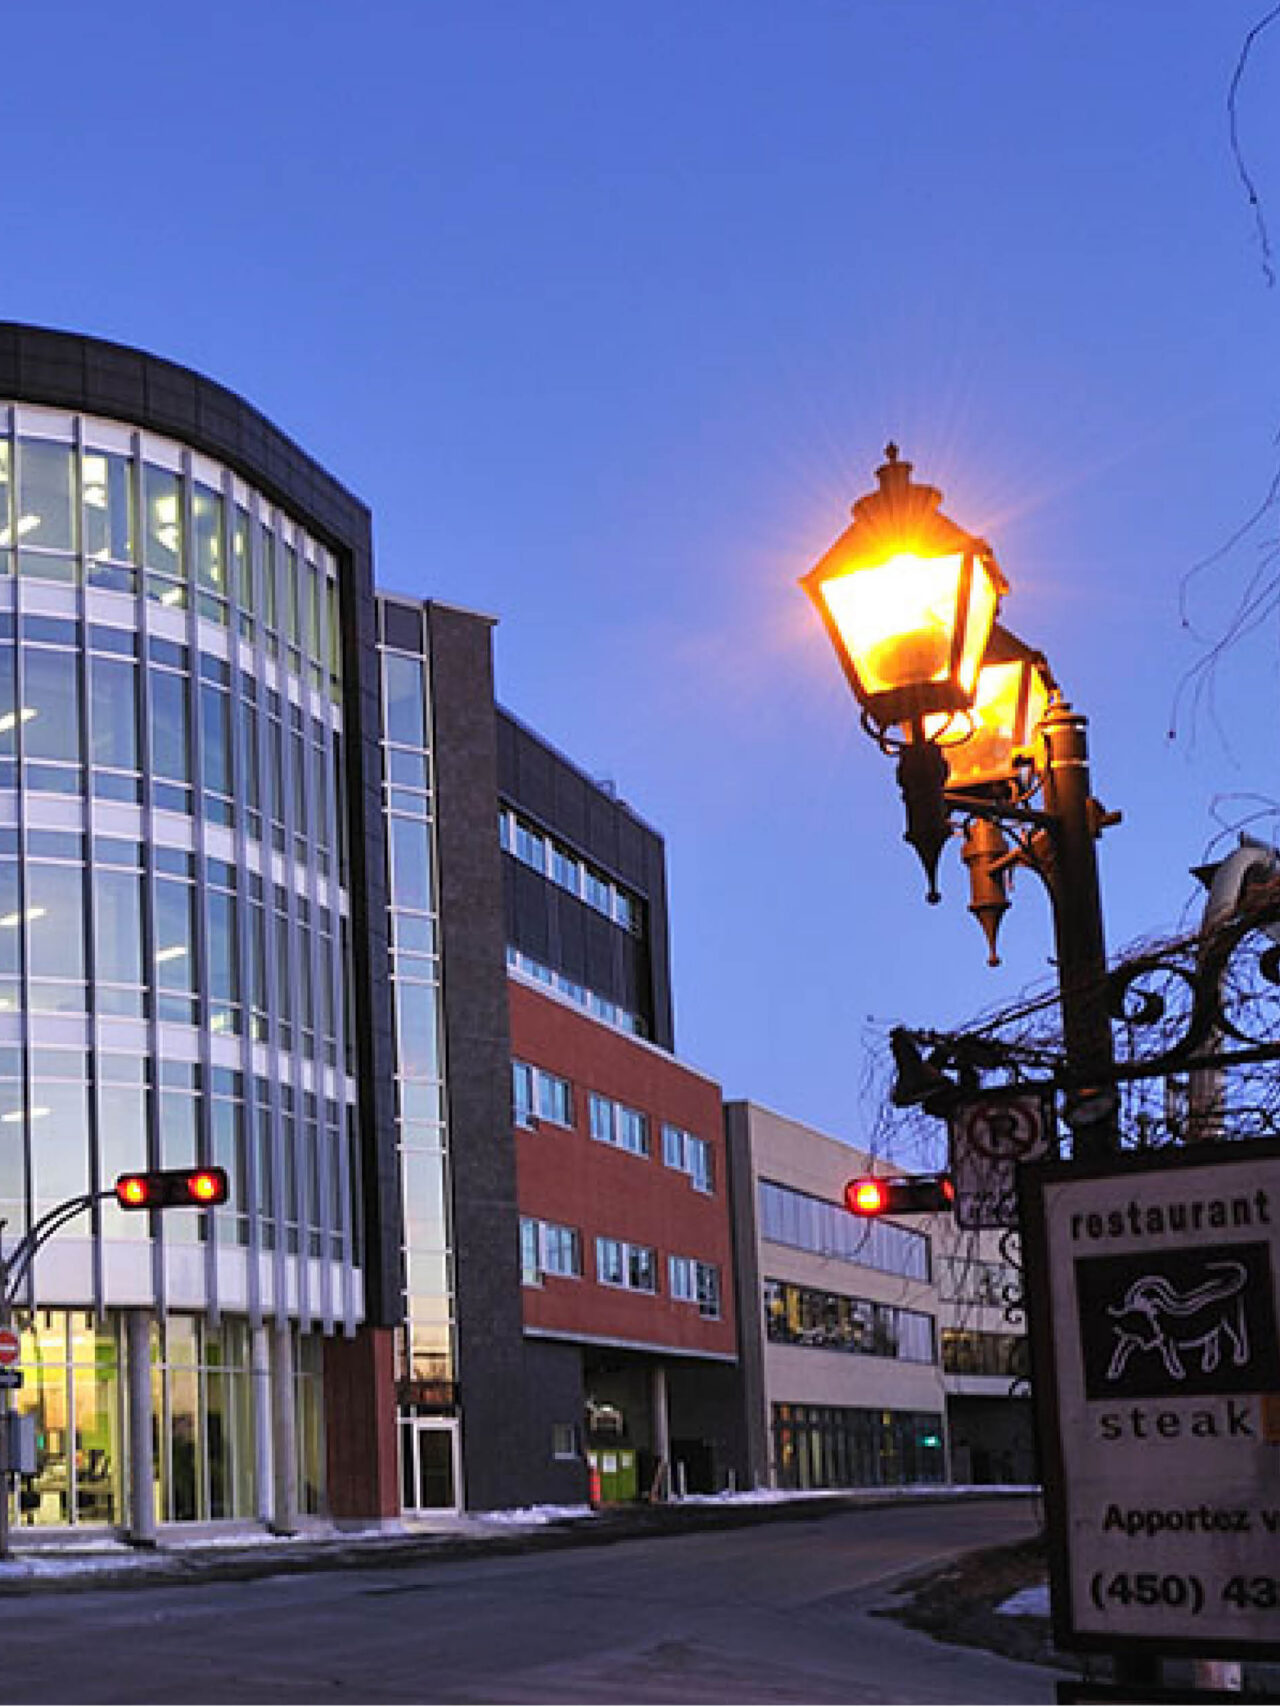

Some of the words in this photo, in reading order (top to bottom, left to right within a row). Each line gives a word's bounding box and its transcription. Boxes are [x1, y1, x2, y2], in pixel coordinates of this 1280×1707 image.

[1072, 1190, 1271, 1240] restaurant
[1100, 1402, 1254, 1440] steak
[1103, 1504, 1249, 1536] Apportez
[1091, 1572, 1205, 1615] (450)
